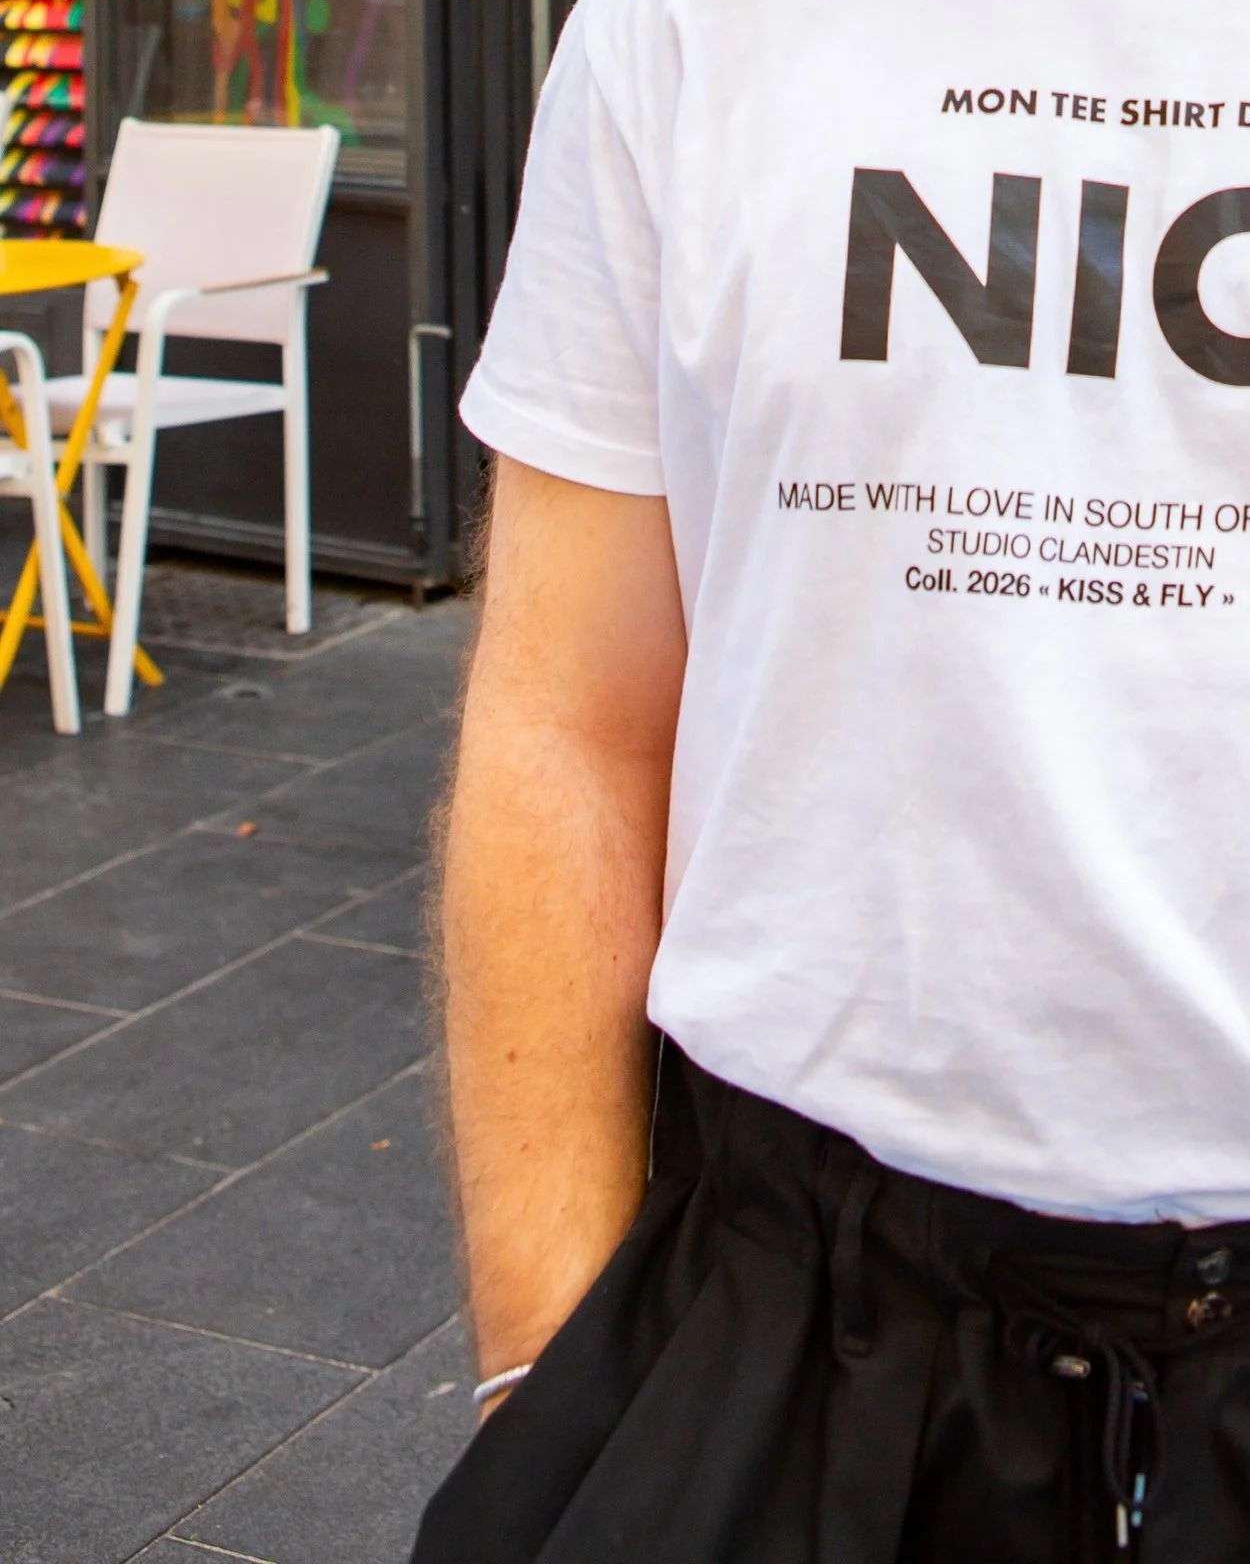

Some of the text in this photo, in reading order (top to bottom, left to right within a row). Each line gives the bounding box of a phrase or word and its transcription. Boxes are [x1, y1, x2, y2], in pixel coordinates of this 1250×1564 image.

[940, 88, 1038, 117] MON
[1050, 91, 1107, 126] TEE
[1119, 98, 1226, 129] SHIRT
[778, 481, 856, 512] MADE
[865, 482, 936, 514] WITH
[946, 485, 1035, 521] LOVE
[1044, 493, 1075, 525] IN
[1083, 498, 1204, 532] SOUTH
[927, 527, 1216, 571] STUDIO CLANDESTIN
[905, 565, 958, 594] Coll.
[966, 569, 1031, 599] 2026
[1057, 577, 1124, 606] KISS
[1131, 583, 1152, 608] &
[1159, 583, 1216, 608] FLY
